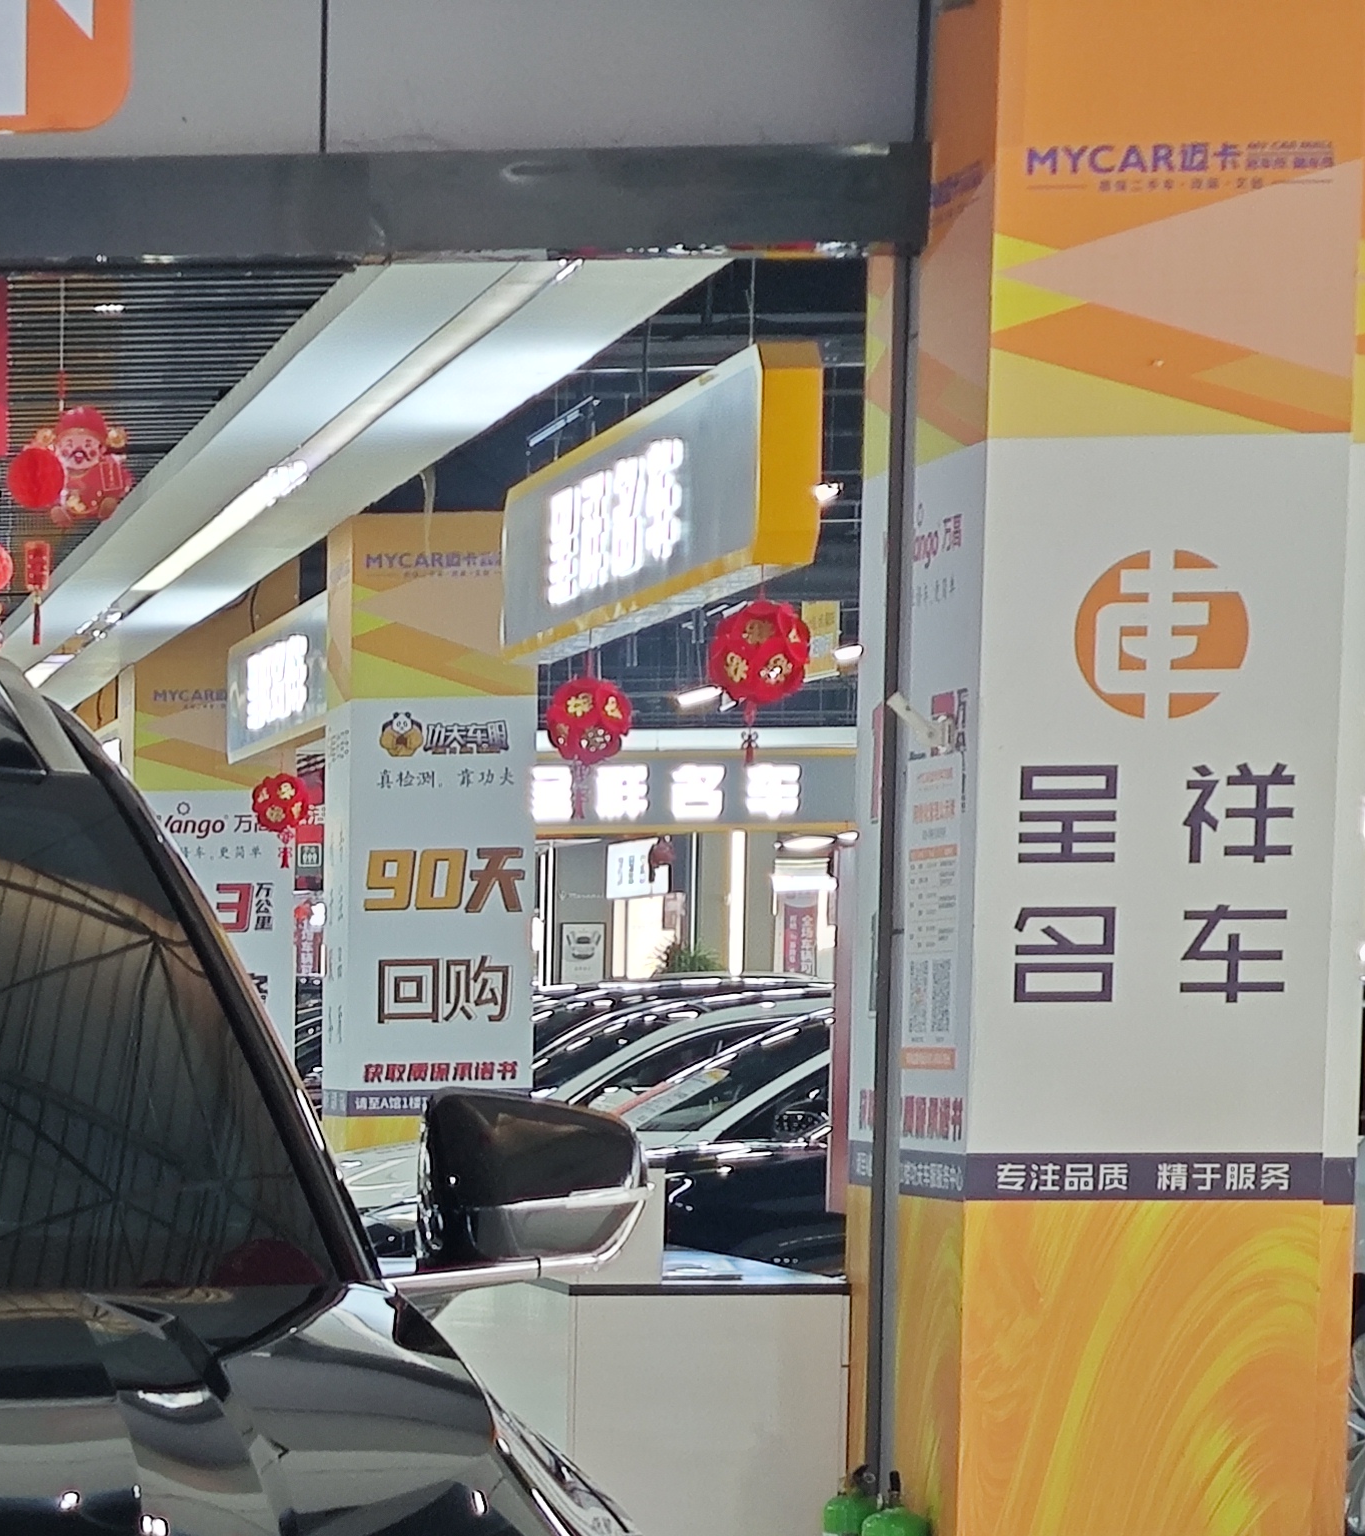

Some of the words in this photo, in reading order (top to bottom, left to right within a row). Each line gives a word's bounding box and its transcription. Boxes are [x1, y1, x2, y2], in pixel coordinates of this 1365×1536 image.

[1017, 761, 1296, 865] 呈祥
[363, 848, 526, 913] 90天
[1013, 903, 1289, 1005] 名车
[377, 957, 511, 1024] 回购
[997, 1162, 1130, 1193] 专注品质
[1157, 1161, 1291, 1192] 精于服务
